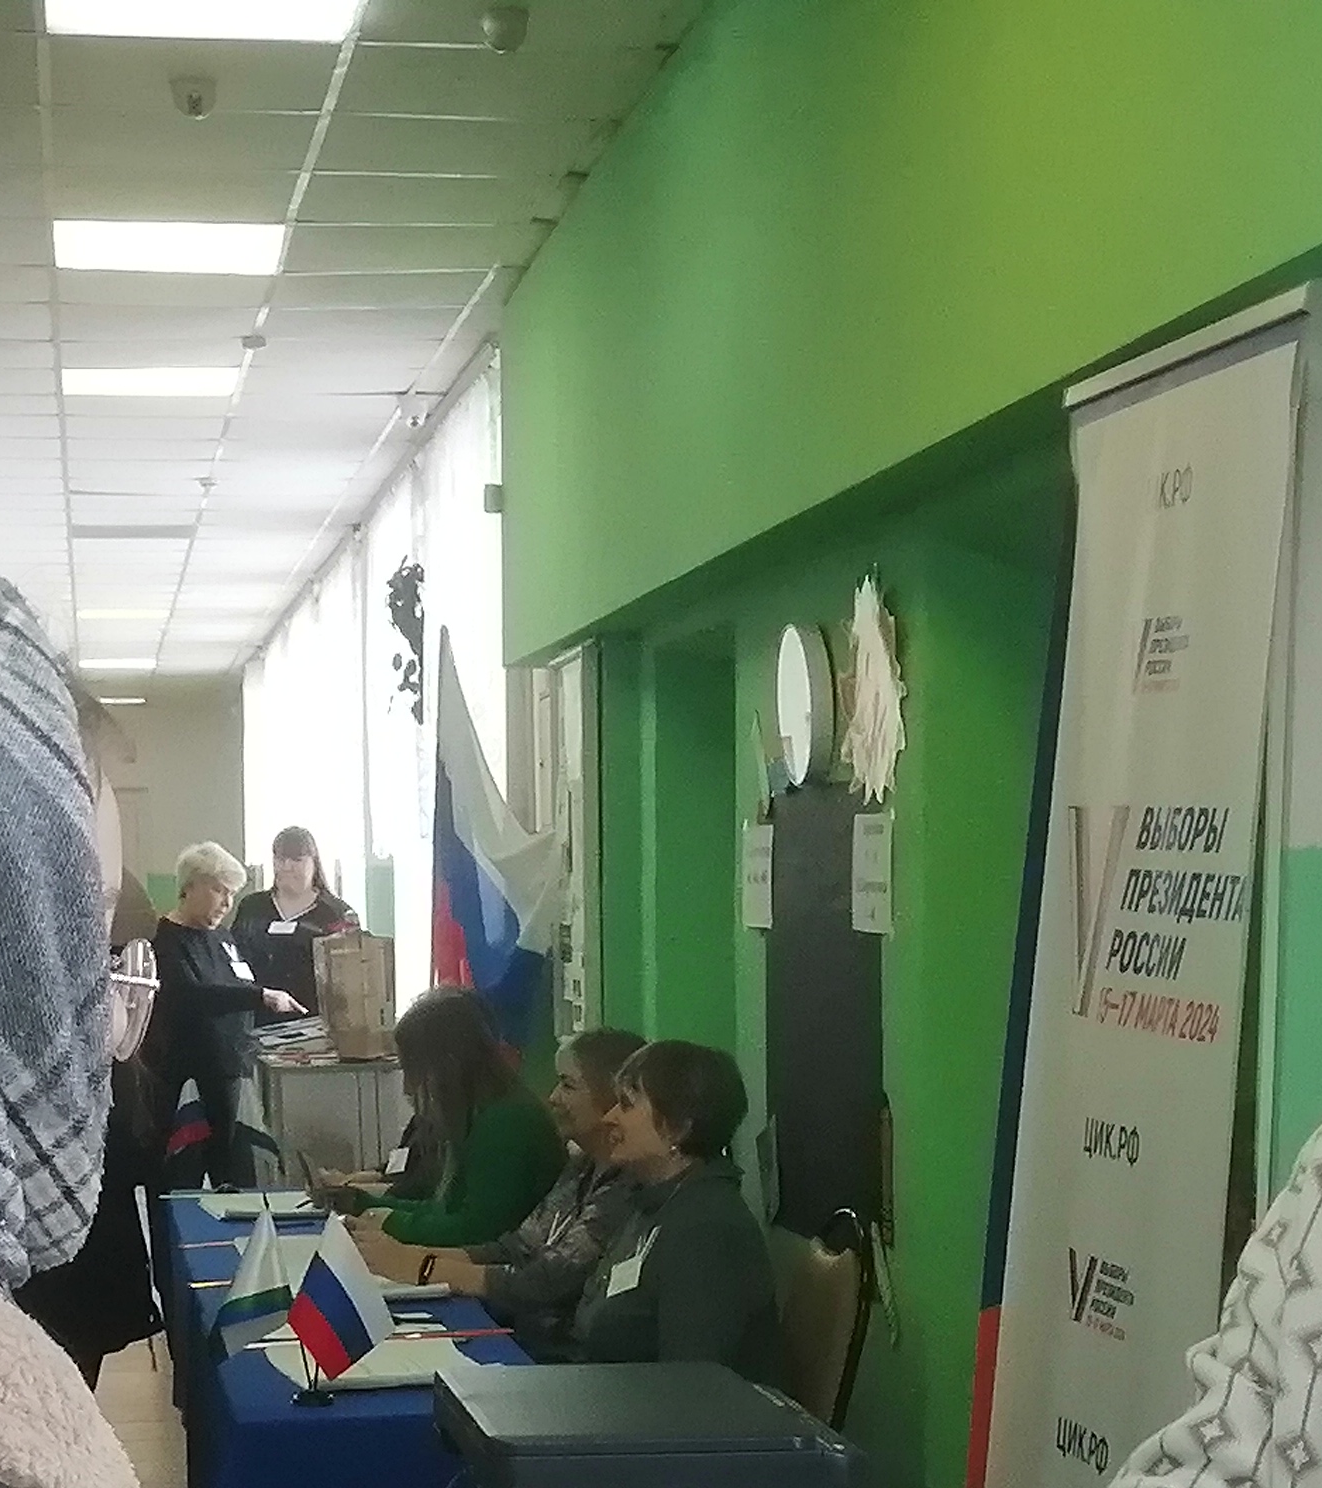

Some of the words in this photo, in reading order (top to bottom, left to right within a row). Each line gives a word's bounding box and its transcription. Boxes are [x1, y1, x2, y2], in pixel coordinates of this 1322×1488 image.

[1135, 805, 1230, 854] ВЫБОРЫ
[1120, 868, 1248, 925] ПРЕЗИДЕНТА
[1105, 928, 1188, 981] РОССИИ
[1133, 991, 1181, 1038] МАРТА
[1179, 999, 1221, 1044] 2024
[1083, 1116, 1141, 1168] ЦИК.РФ
[1056, 1416, 1110, 1476] ЦИК.РФ
